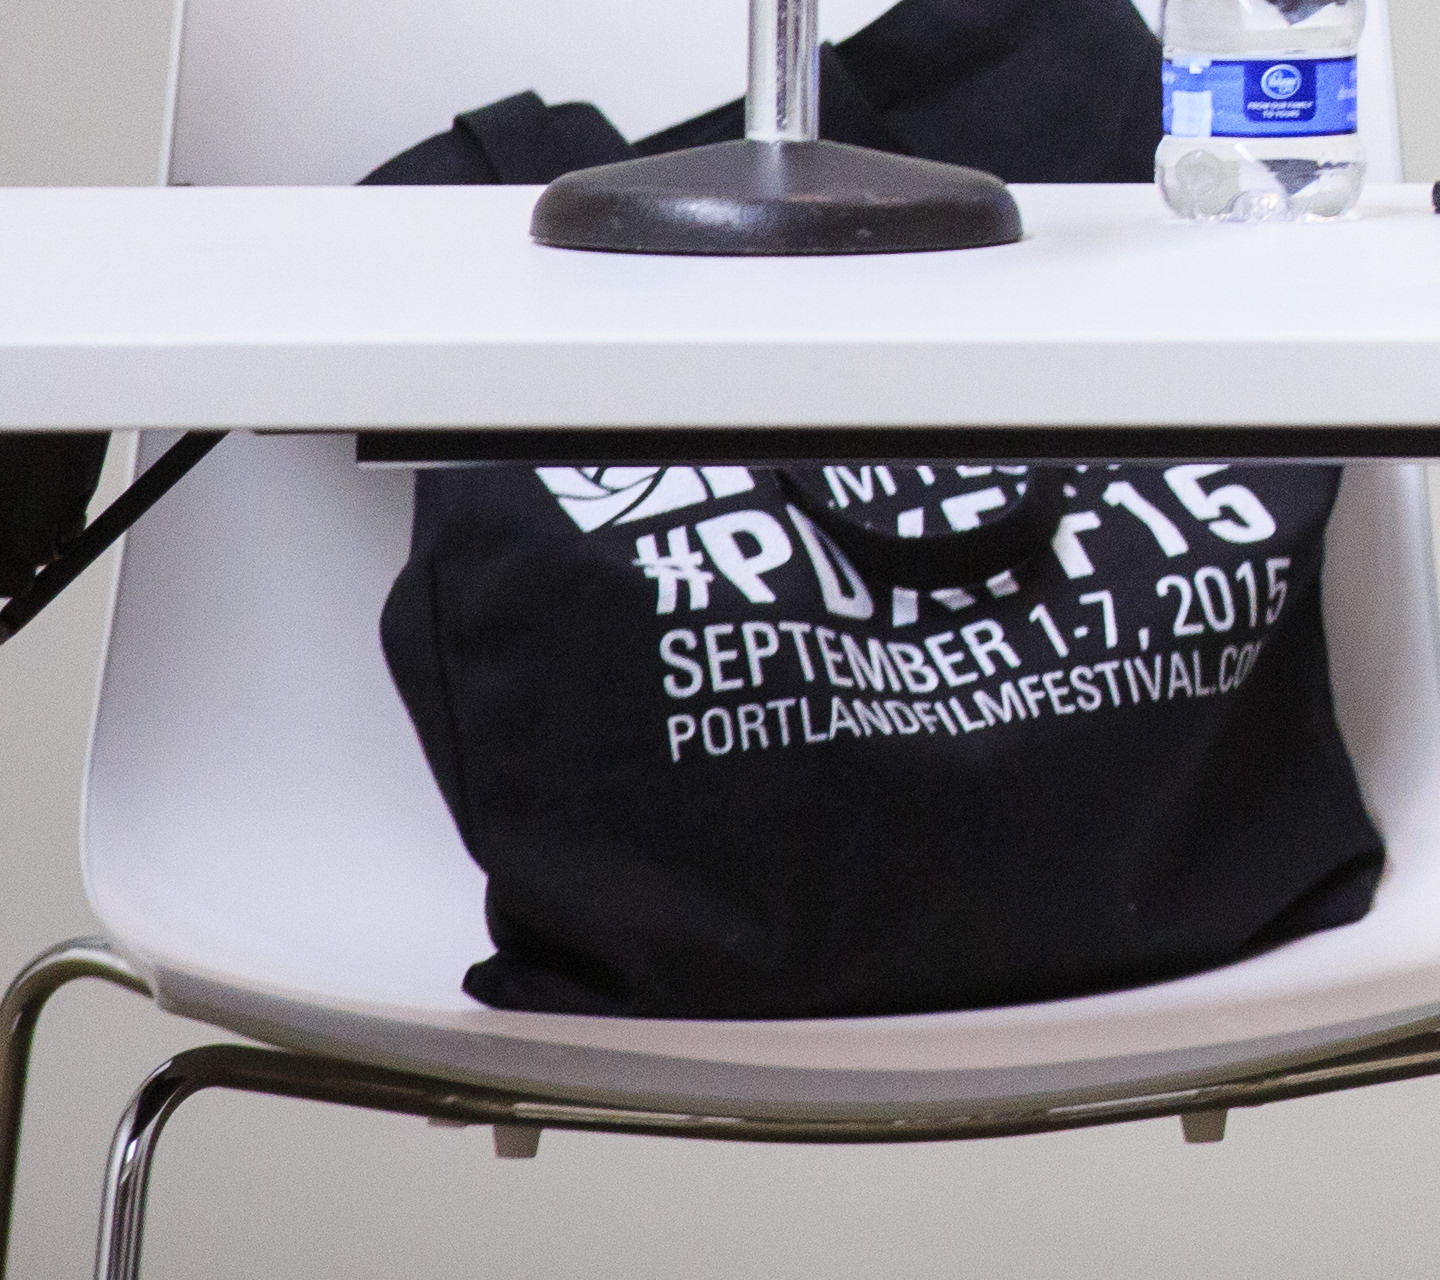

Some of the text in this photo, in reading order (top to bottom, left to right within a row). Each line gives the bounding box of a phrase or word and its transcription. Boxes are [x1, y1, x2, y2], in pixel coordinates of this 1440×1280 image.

[658, 618, 1023, 699] SEPTEMBER
[1155, 556, 1292, 637] 2015
[666, 640, 1263, 764] PORTLANDFILMFESTIVAL.CO
